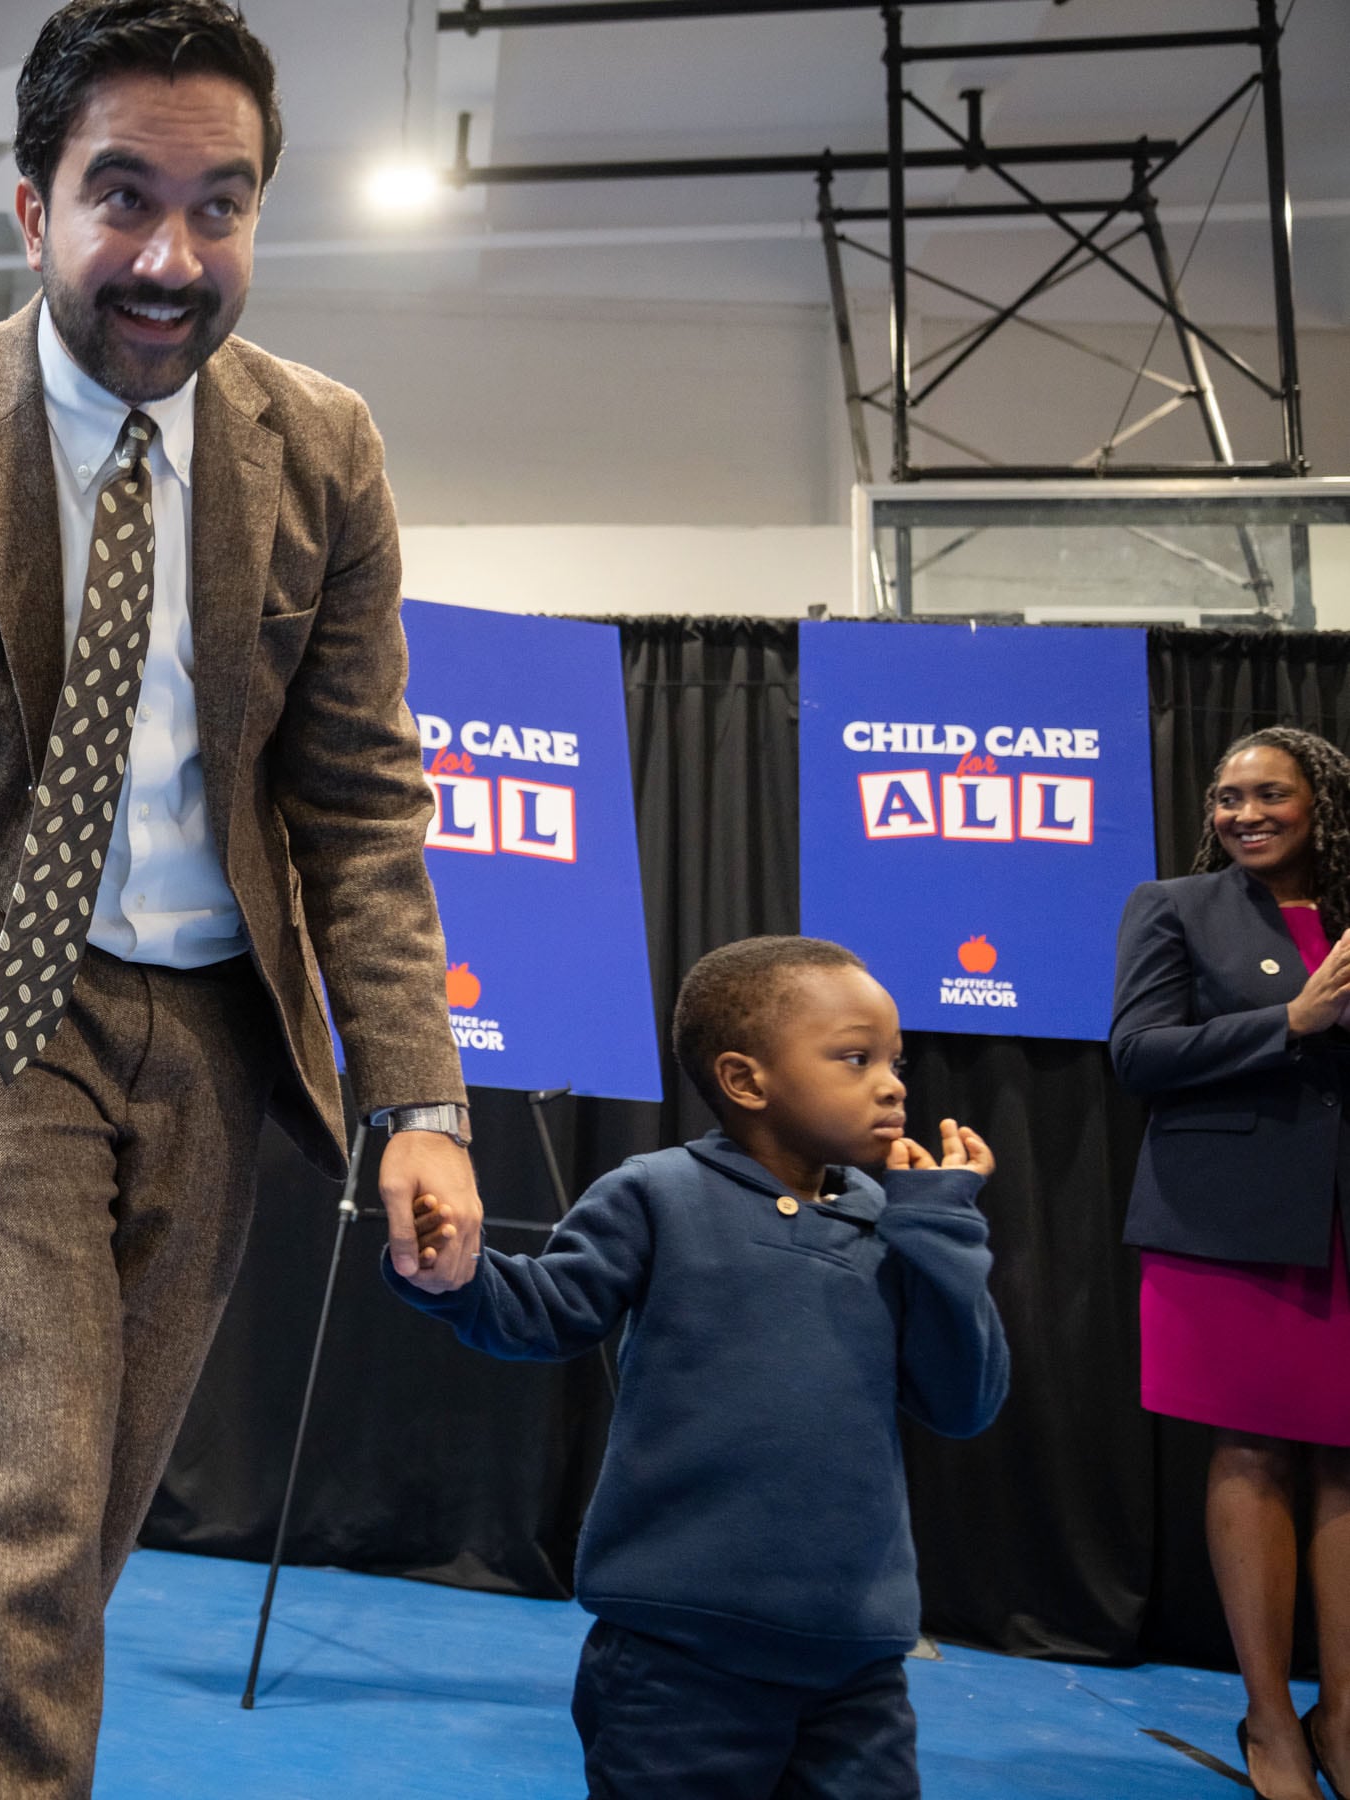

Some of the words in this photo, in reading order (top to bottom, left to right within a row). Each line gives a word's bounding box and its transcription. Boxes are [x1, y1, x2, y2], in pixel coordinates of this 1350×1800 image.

[460, 720, 579, 767] CARE
[842, 721, 977, 755] CHILD
[984, 725, 1099, 759] CARE
[430, 746, 475, 776] for
[956, 751, 998, 777] for
[433, 782, 557, 848] LL
[874, 780, 1075, 832] ALL
[940, 986, 1018, 1008] MAYOR
[954, 977, 995, 990] OFFICE
[450, 1027, 506, 1051] YOR
